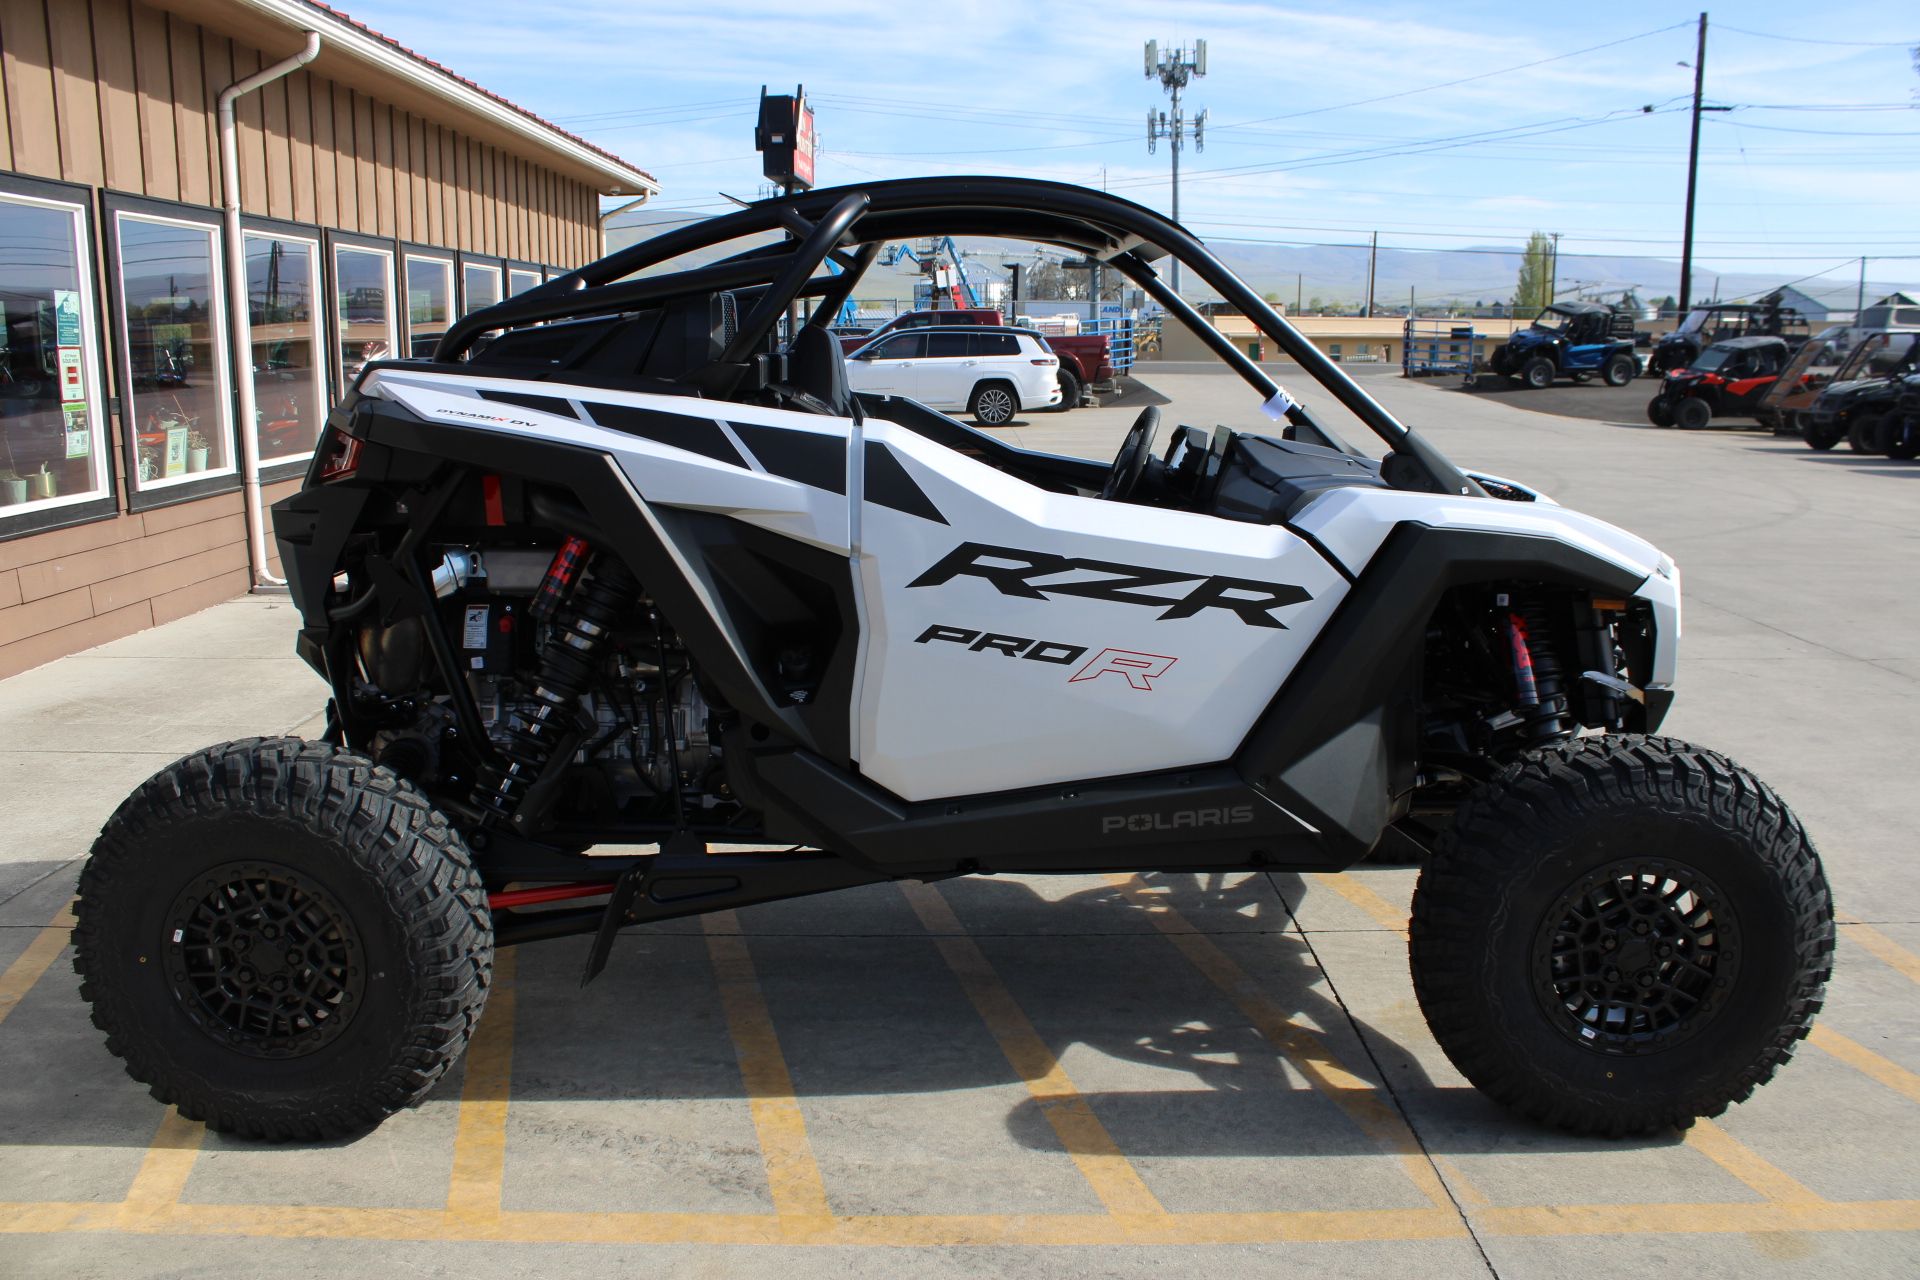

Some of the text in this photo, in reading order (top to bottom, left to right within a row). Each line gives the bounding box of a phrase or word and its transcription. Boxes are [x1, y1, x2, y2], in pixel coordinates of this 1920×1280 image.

[436, 409, 510, 421] DYNAMIX
[904, 541, 1314, 630] RZR
[913, 624, 1178, 691] PRO R
[1102, 805, 1254, 834] POLARIS
